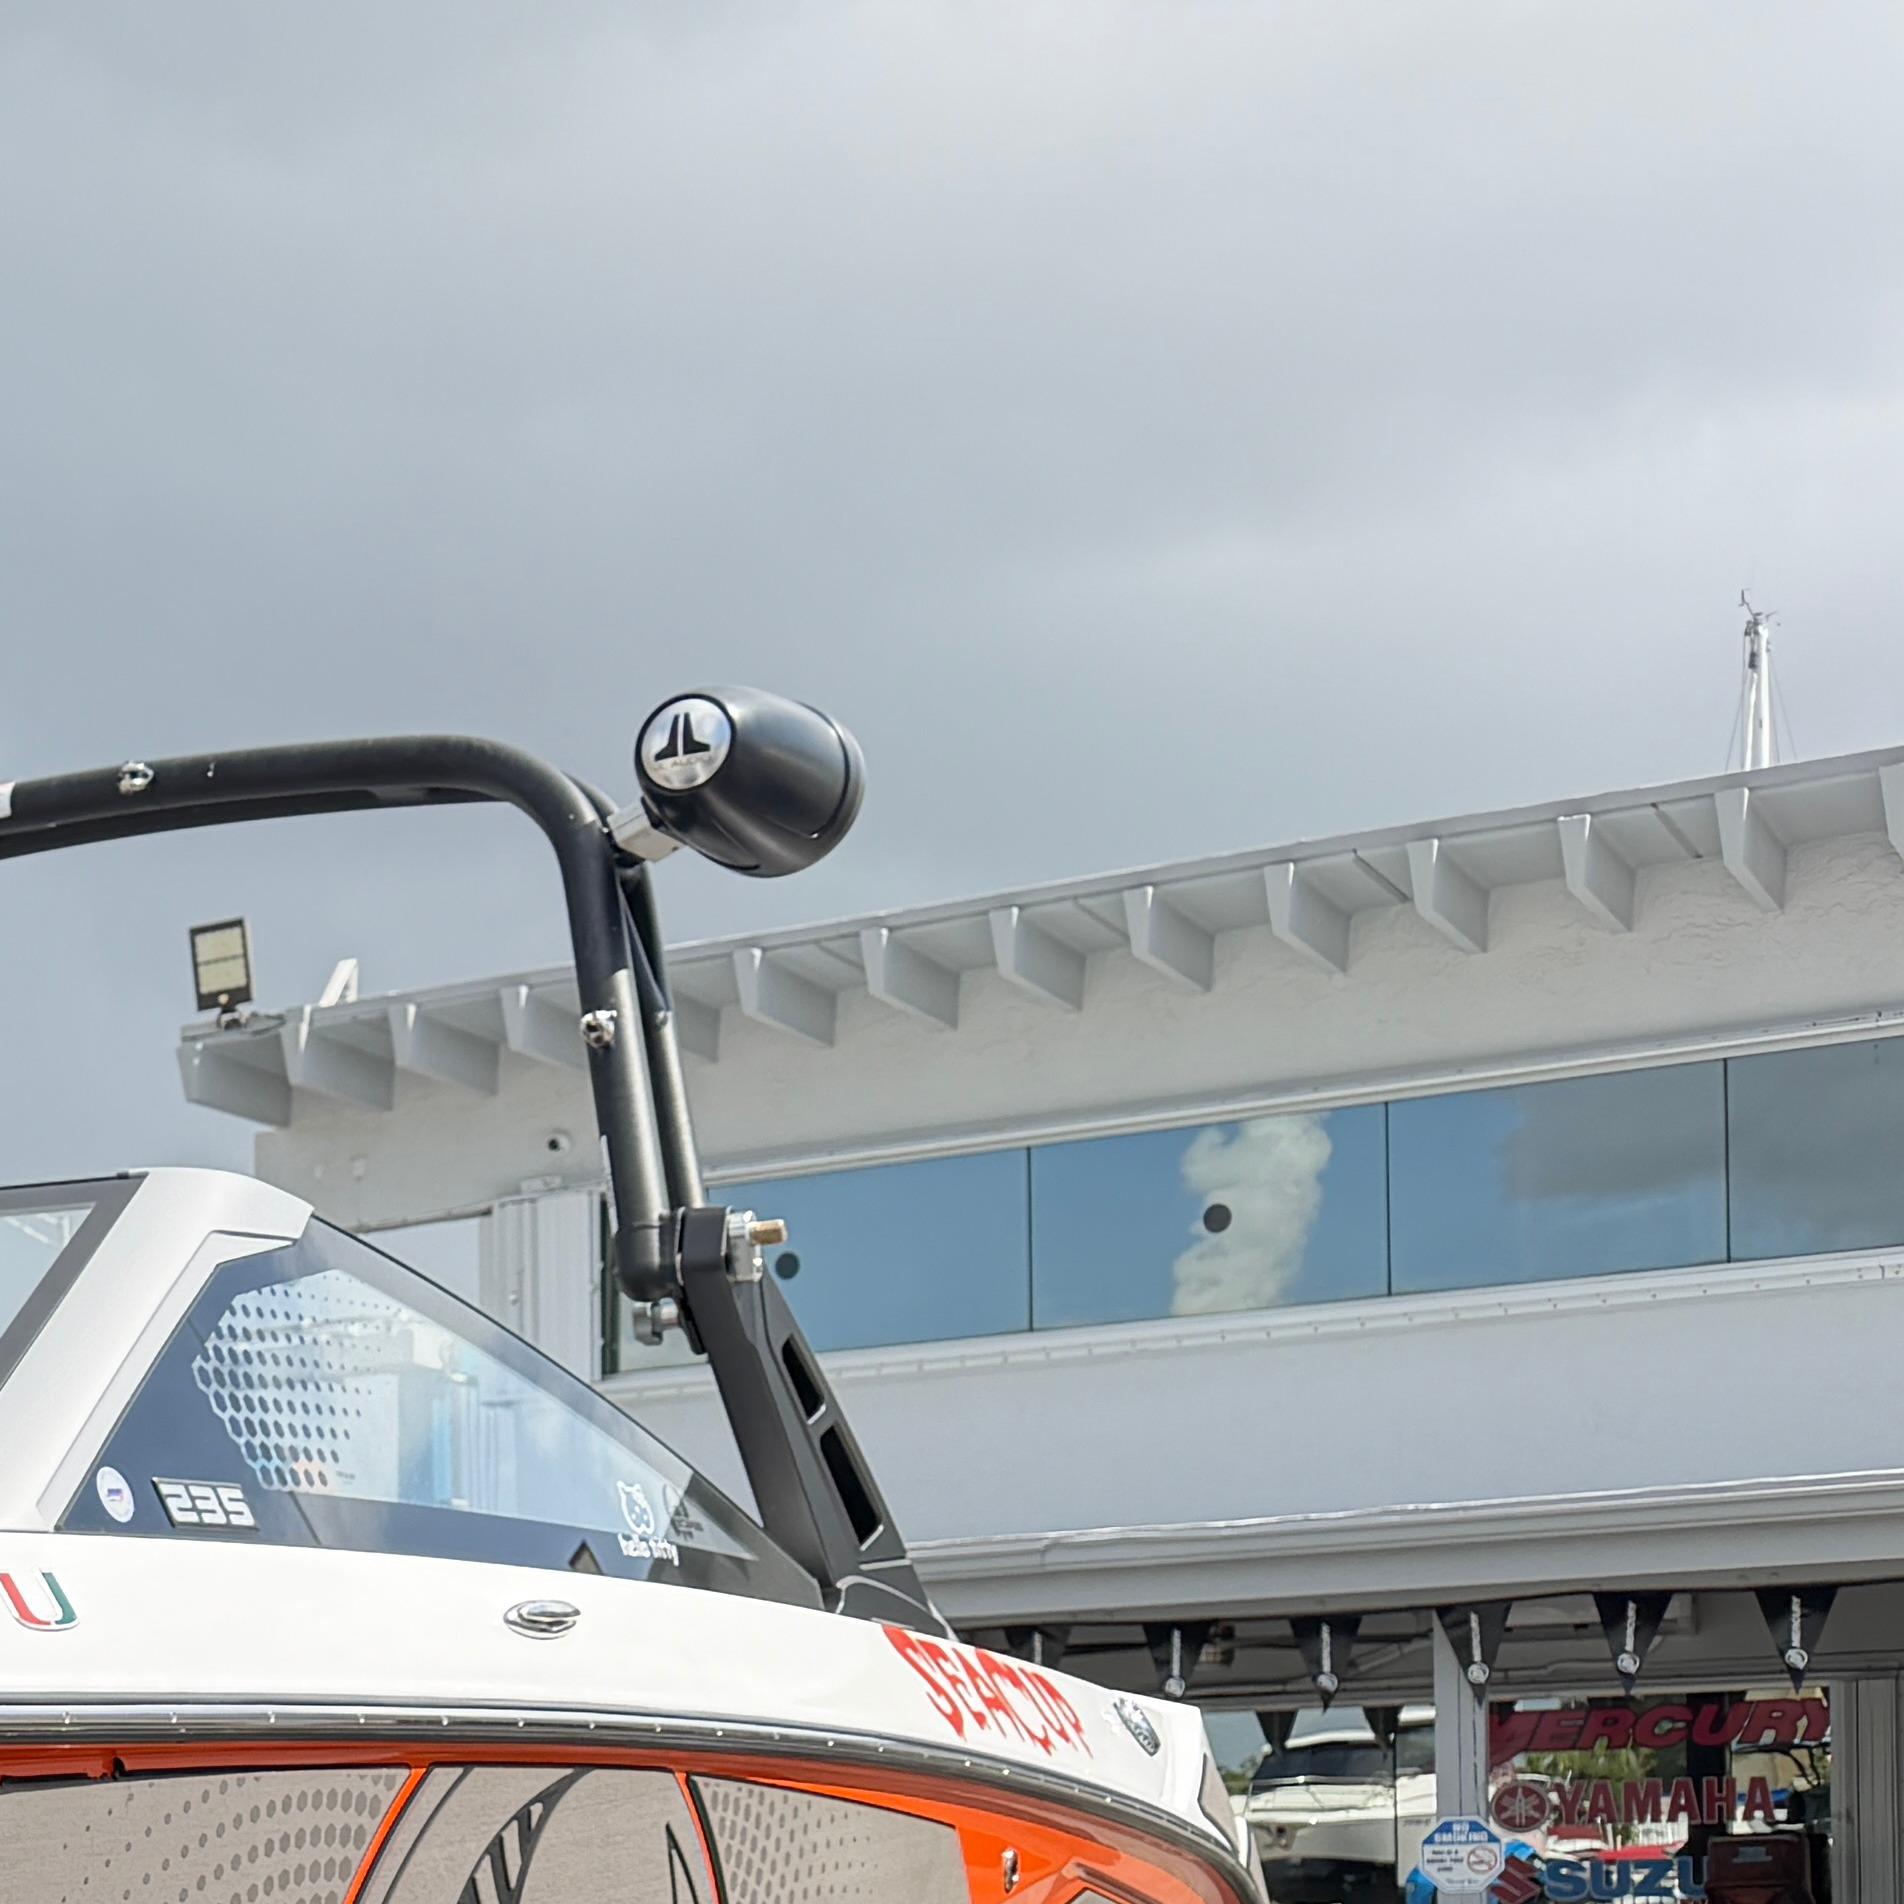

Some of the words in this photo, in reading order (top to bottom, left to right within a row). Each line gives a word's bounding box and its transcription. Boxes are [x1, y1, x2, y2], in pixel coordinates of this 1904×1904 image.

[156, 1481, 257, 1526] 235
[1554, 1776, 1775, 1825] YAMAHA
[1542, 1853, 1710, 1899] SUZU
